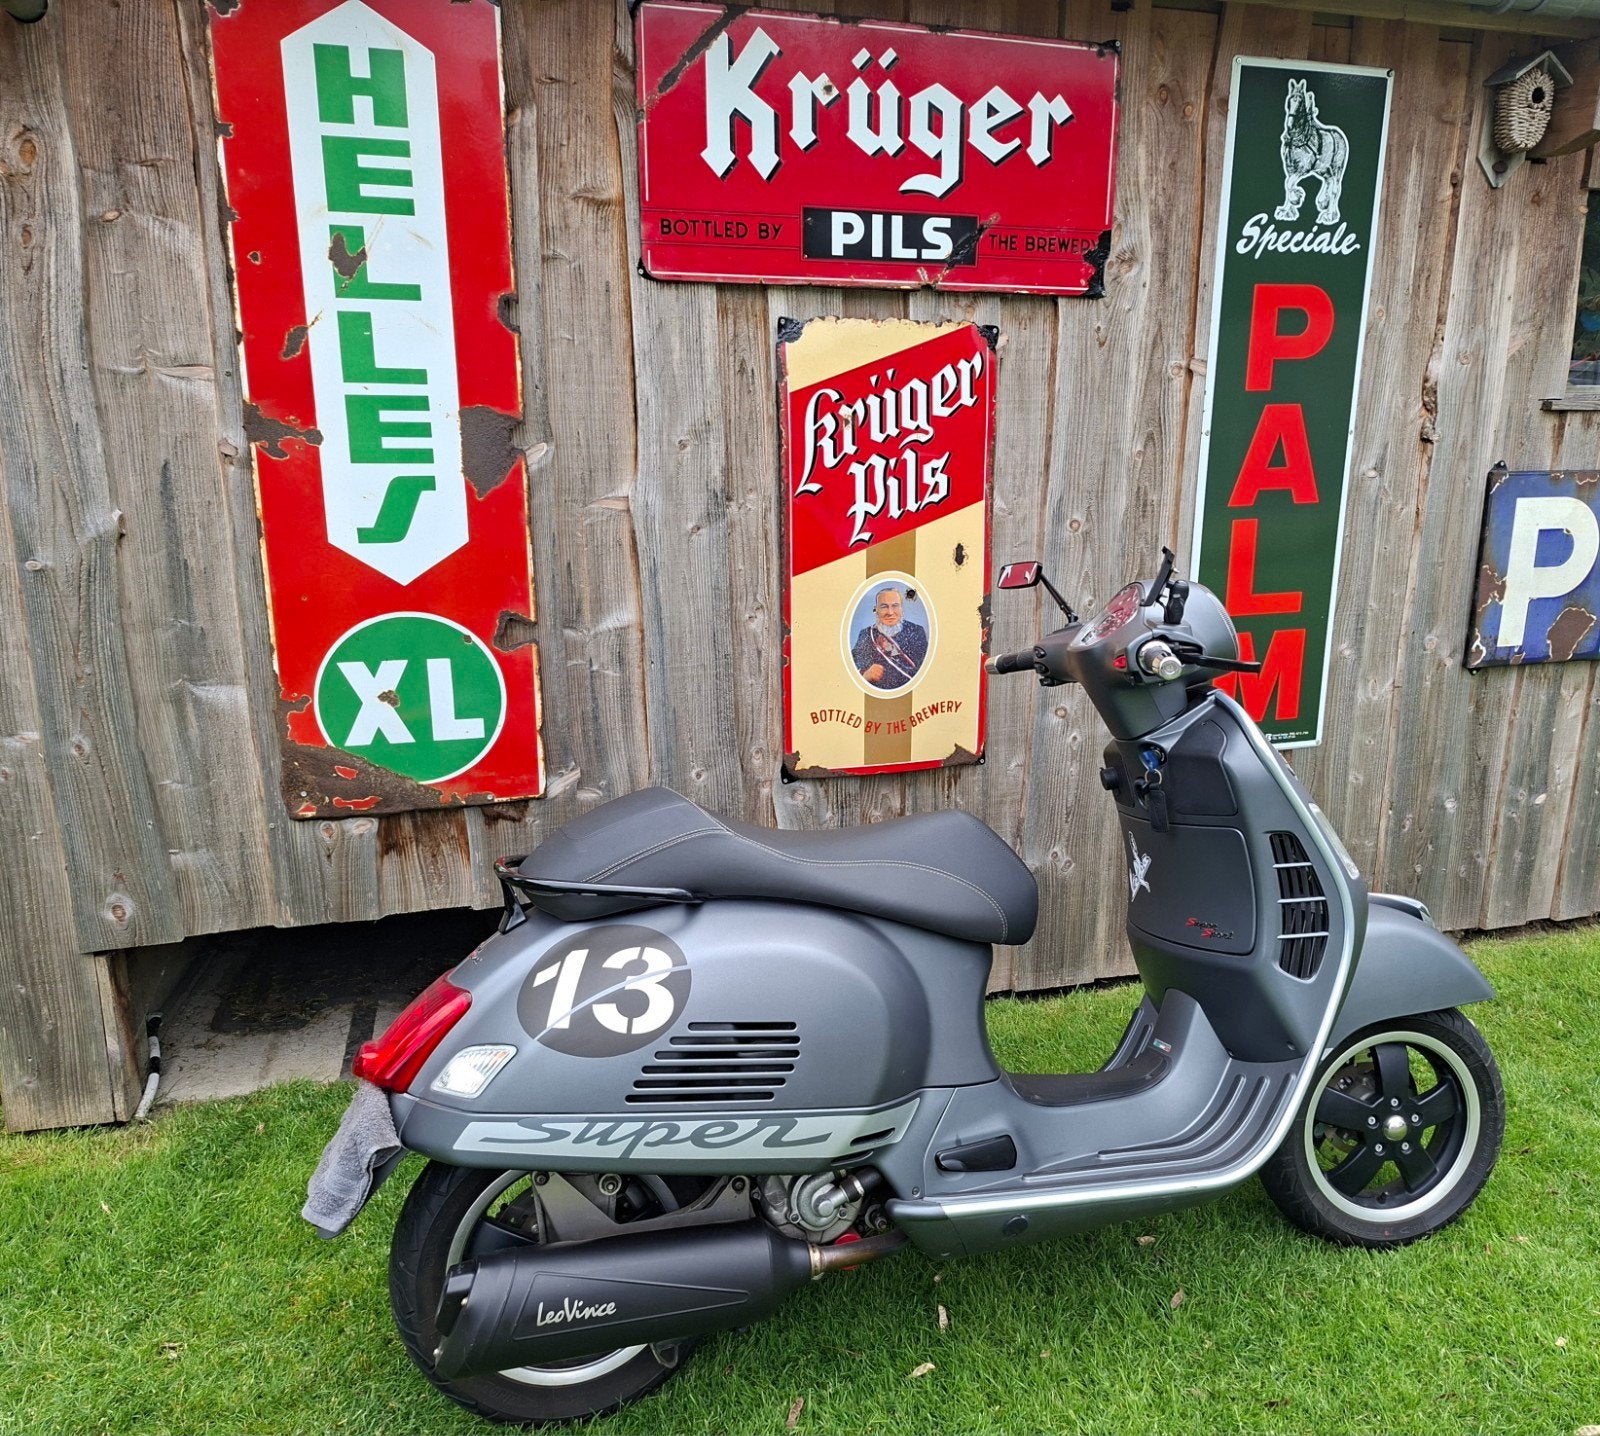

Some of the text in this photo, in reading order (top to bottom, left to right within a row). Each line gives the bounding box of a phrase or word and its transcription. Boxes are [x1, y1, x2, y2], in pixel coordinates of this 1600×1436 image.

[700, 26, 1074, 200] Krüger
[660, 218, 784, 240] BOTTLED BY
[831, 211, 955, 260] PILS
[988, 234, 1018, 251] THE
[1235, 213, 1361, 259] Speciale
[313, 43, 437, 544] HELLES
[793, 350, 985, 497] Krüger
[846, 448, 951, 549] Pils
[1212, 283, 1335, 722] PALM
[1496, 496, 1600, 647] P
[336, 658, 486, 747] XL
[810, 700, 962, 735] BOTTLED BY THE BREWERY
[532, 946, 675, 1035] 13
[536, 1297, 617, 1327] LeoVince
